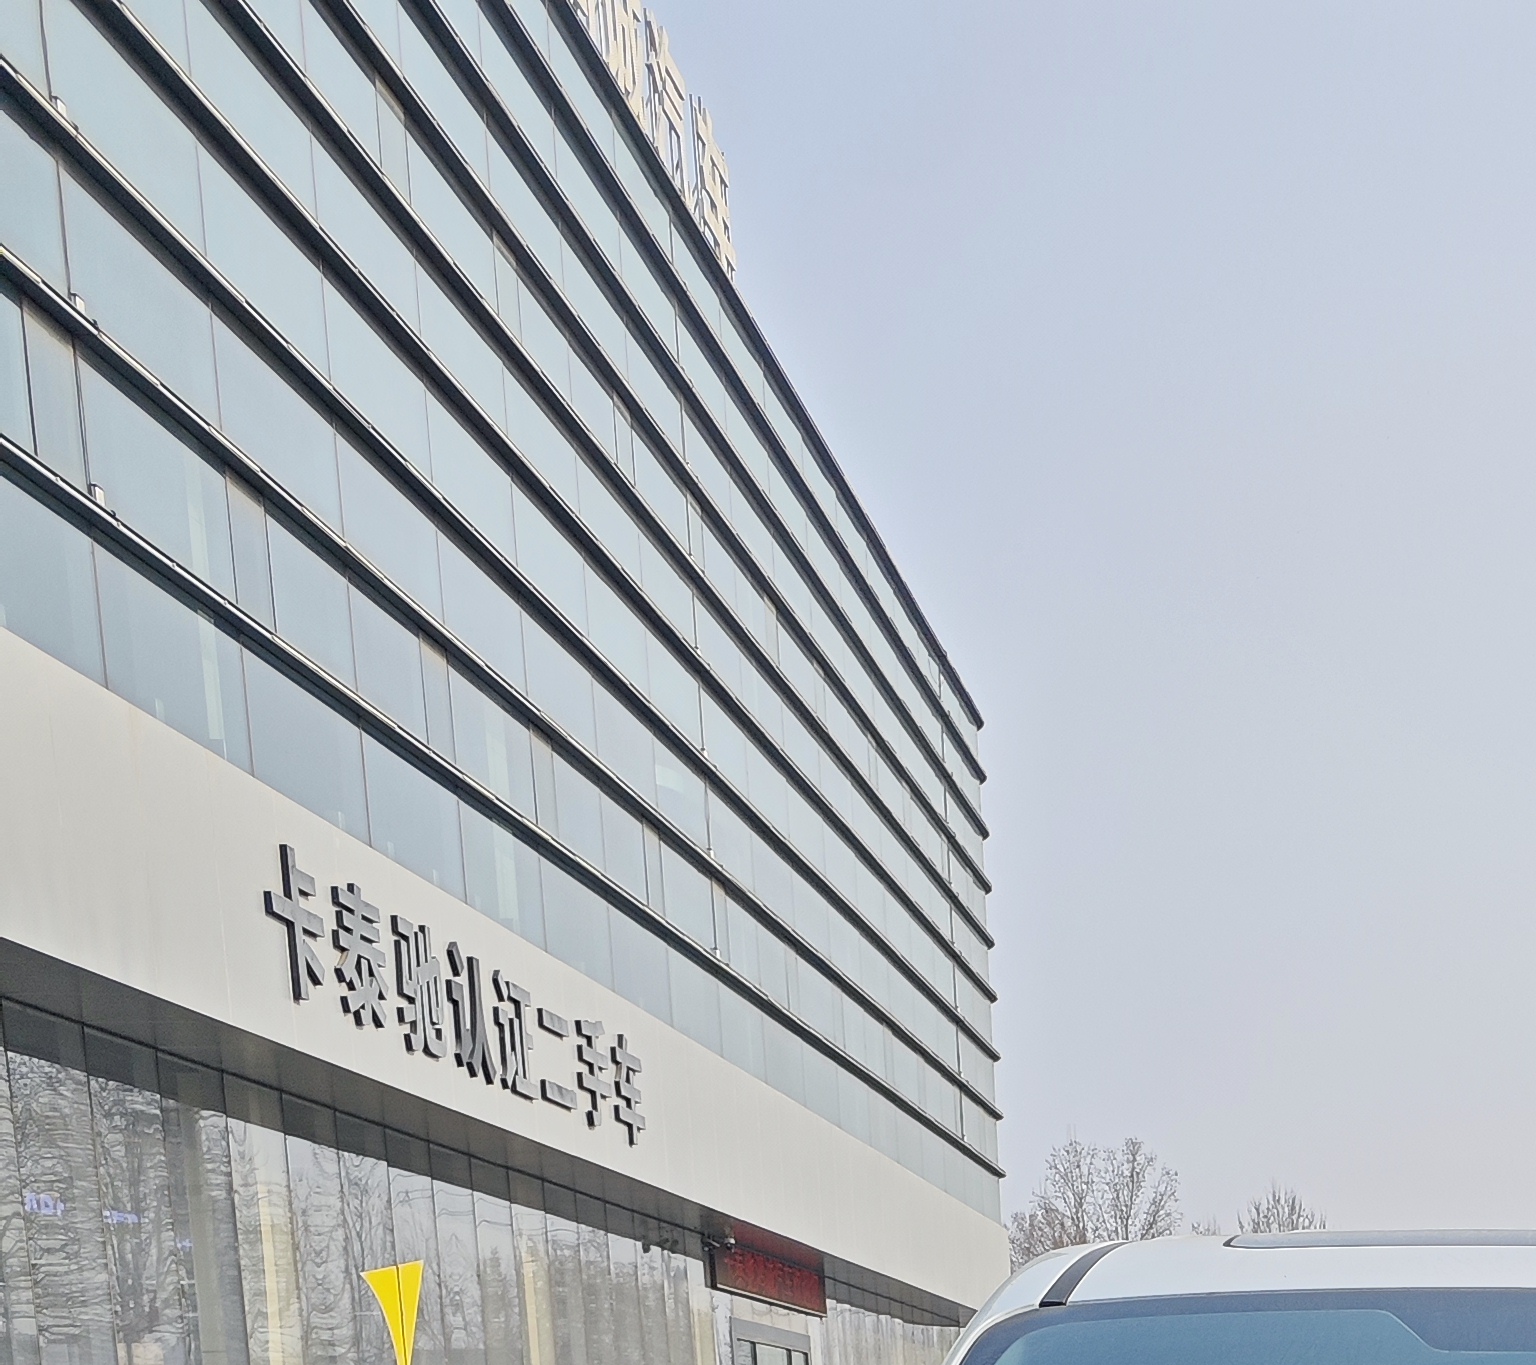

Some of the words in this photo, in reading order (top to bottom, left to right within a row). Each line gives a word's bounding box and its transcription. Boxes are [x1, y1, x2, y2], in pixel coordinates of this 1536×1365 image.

[263, 843, 646, 1148] 卡泰驰认证二手车
